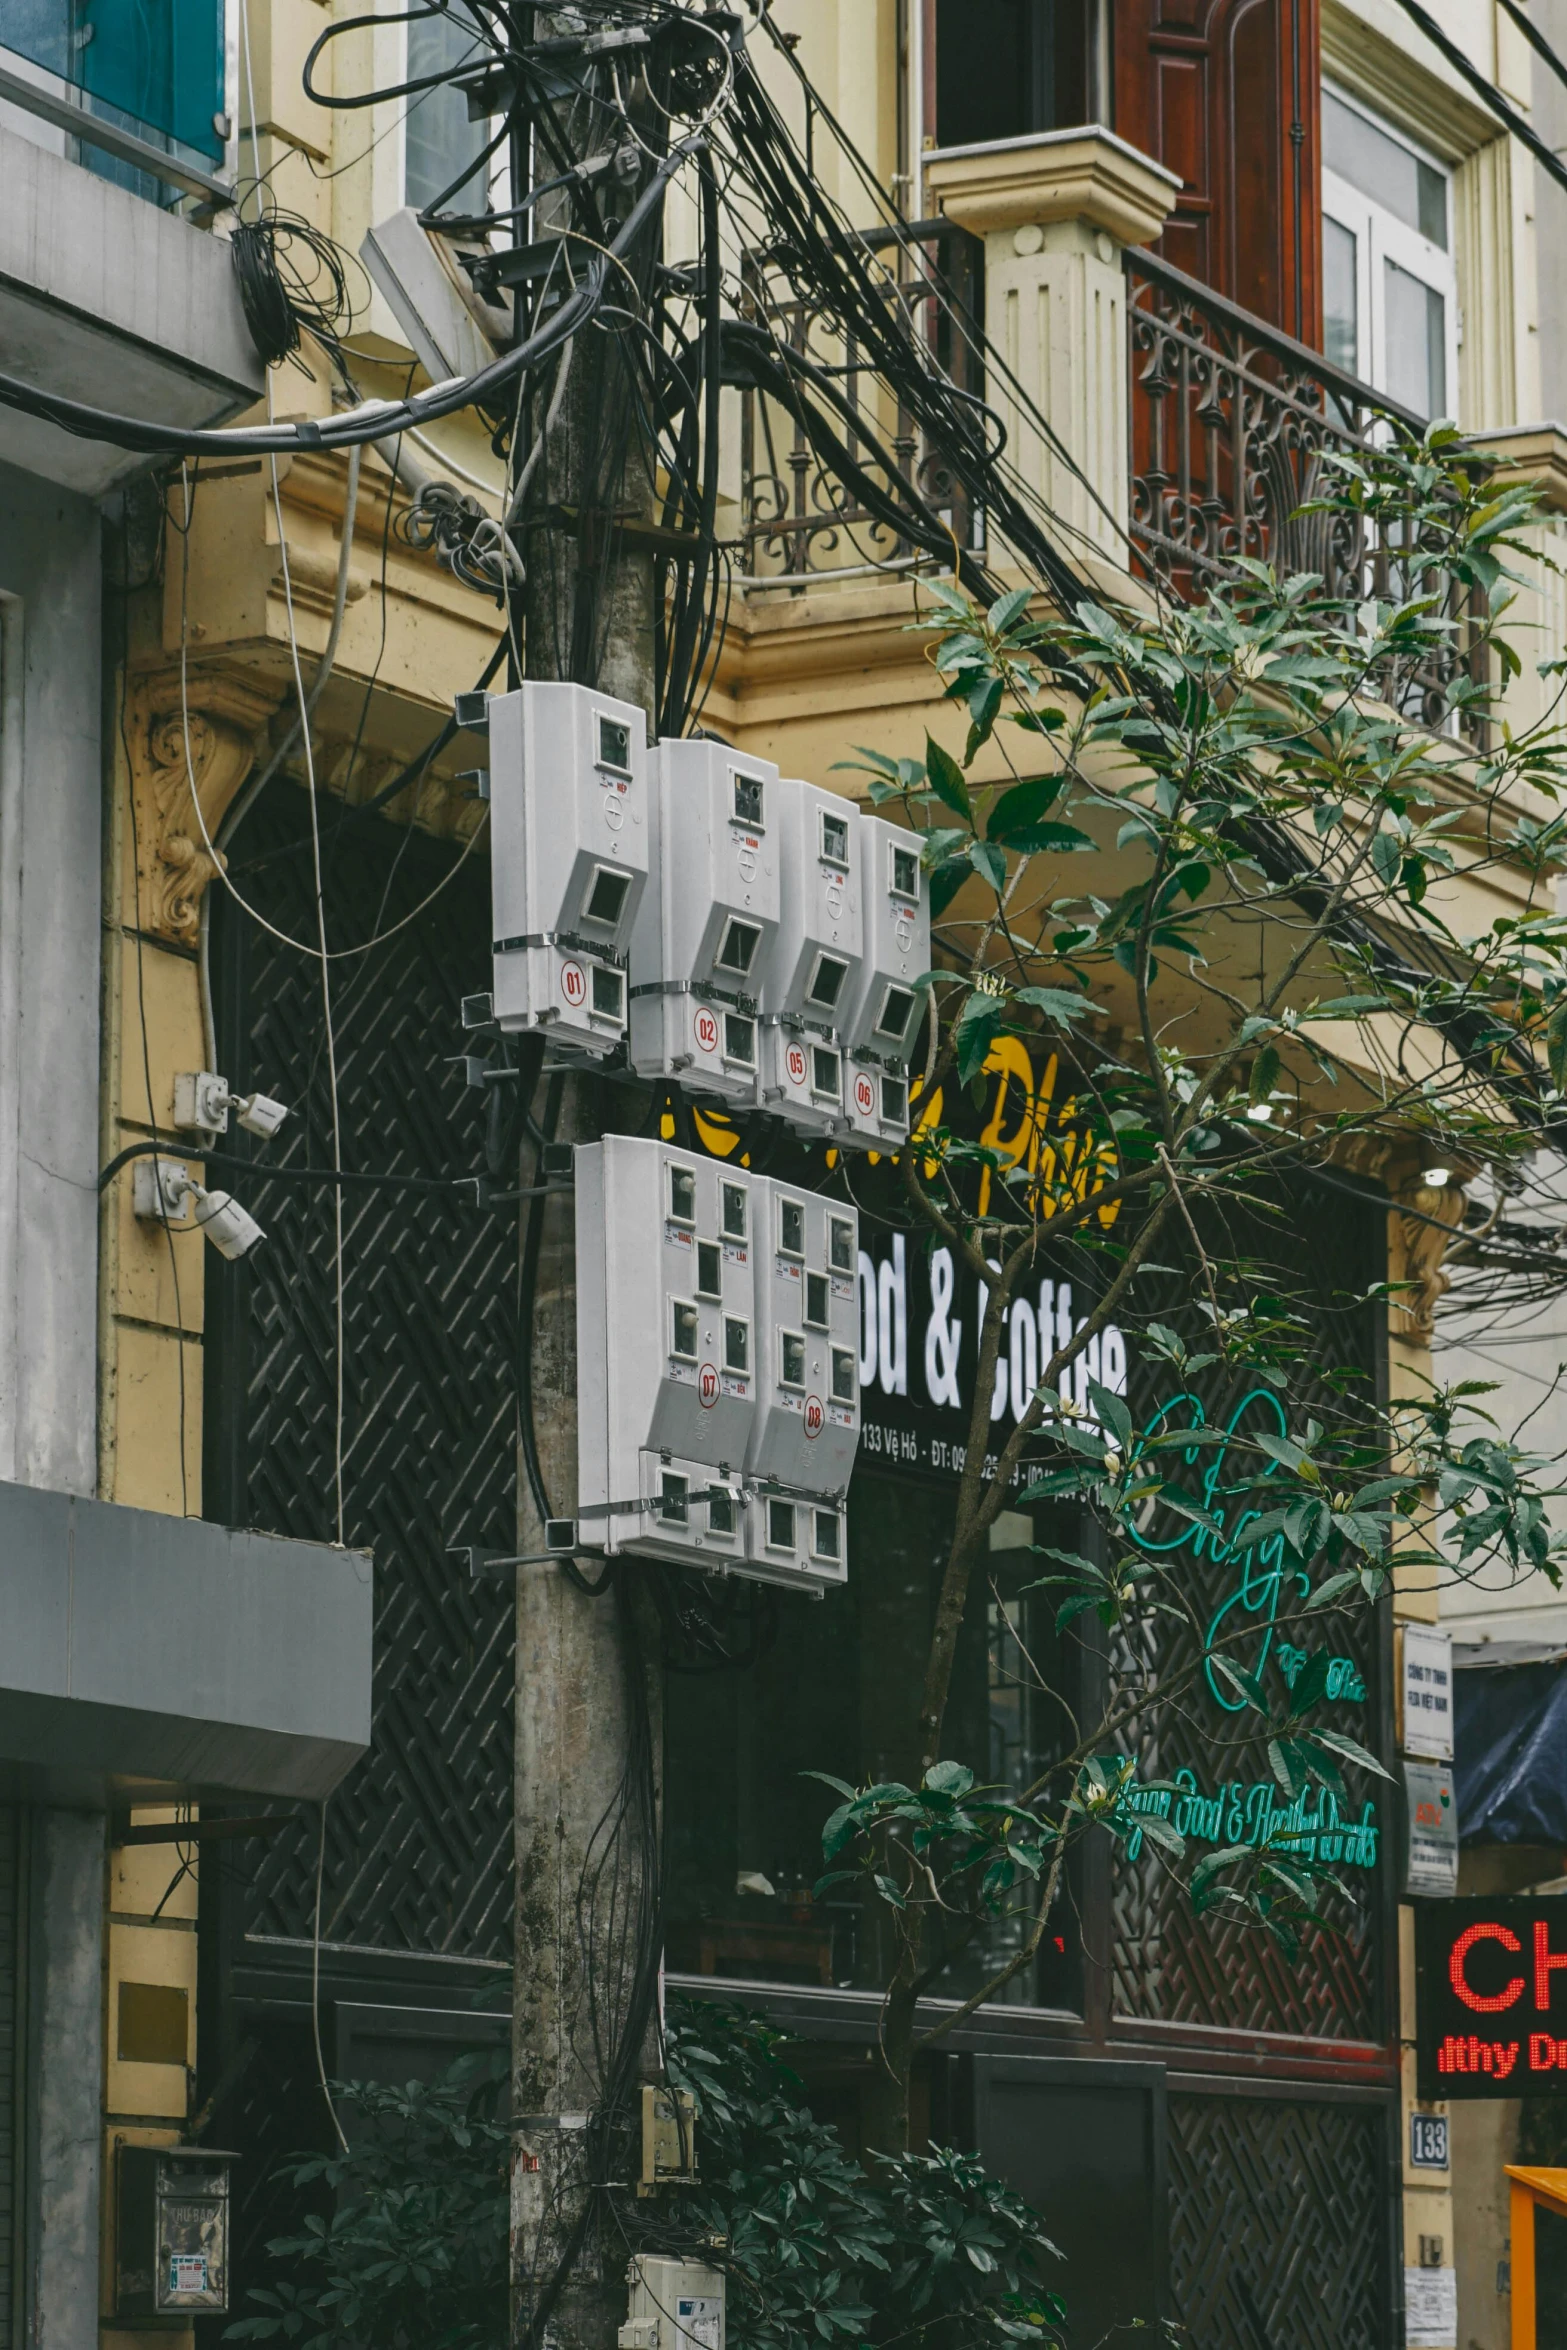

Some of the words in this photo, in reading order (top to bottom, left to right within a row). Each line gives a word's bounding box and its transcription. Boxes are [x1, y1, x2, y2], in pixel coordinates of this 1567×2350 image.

[566, 971, 581, 995] 01
[700, 1018, 714, 1042] 02
[790, 1052, 803, 1075] 05
[858, 1082, 871, 1107] 06
[925, 1246, 962, 1409] &
[703, 1374, 715, 1397] 07
[808, 1405, 821, 1429] 08
[862, 1422, 881, 1452] 133
[883, 1427, 899, 1462] Vệ
[1227, 1781, 1245, 1844] &
[1415, 2121, 1445, 2159] 133
